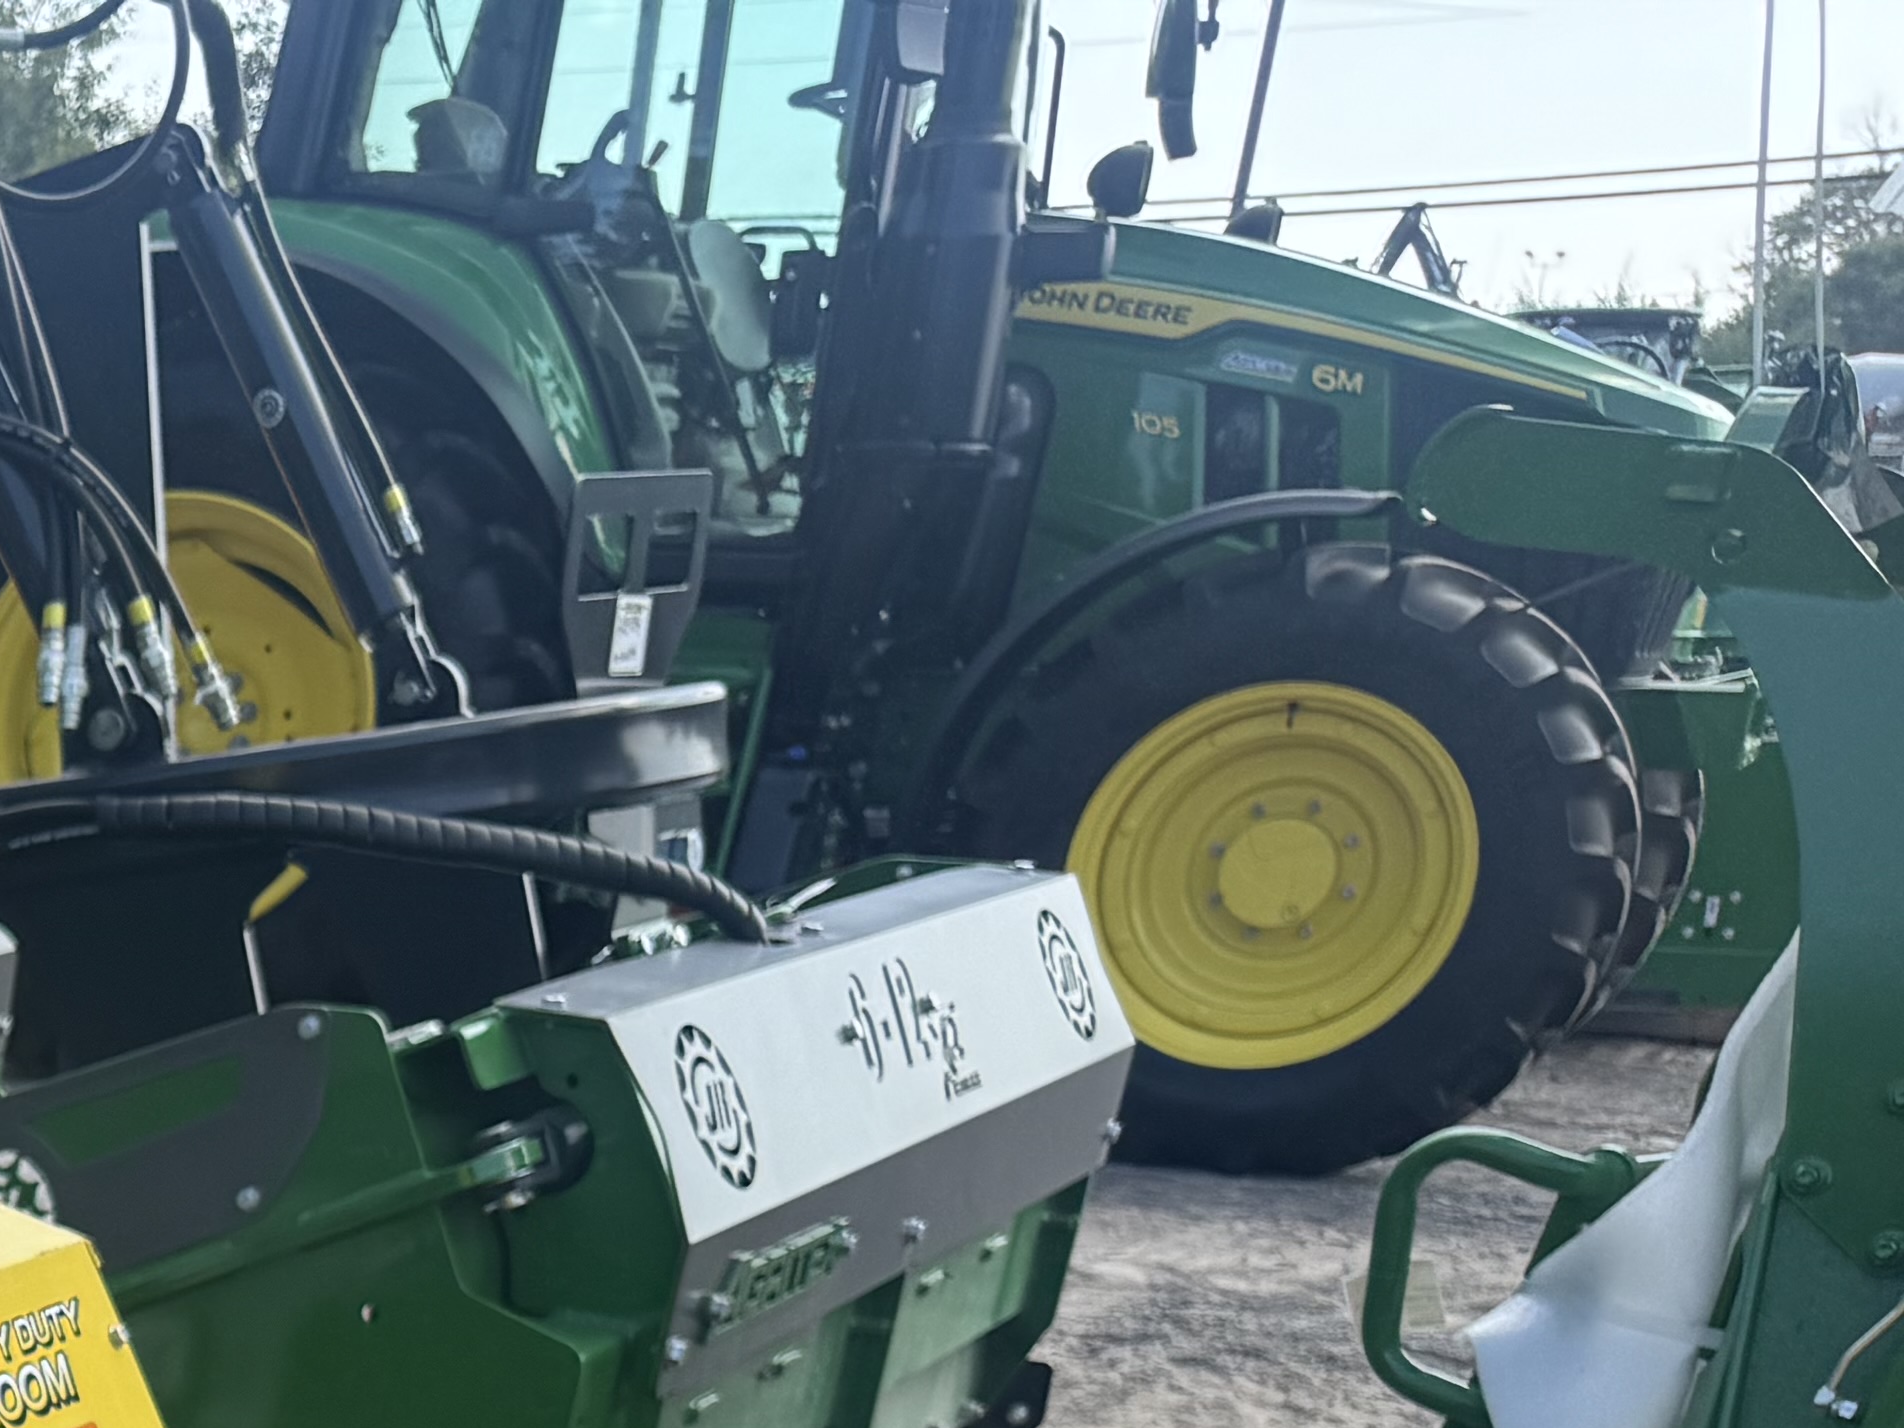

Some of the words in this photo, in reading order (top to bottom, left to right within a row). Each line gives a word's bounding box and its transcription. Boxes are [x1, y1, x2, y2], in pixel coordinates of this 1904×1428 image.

[1094, 291, 1193, 326] DEERE
[1311, 364, 1364, 395] 6M
[1130, 410, 1182, 439] 105
[11, 1296, 81, 1354] DUTY
